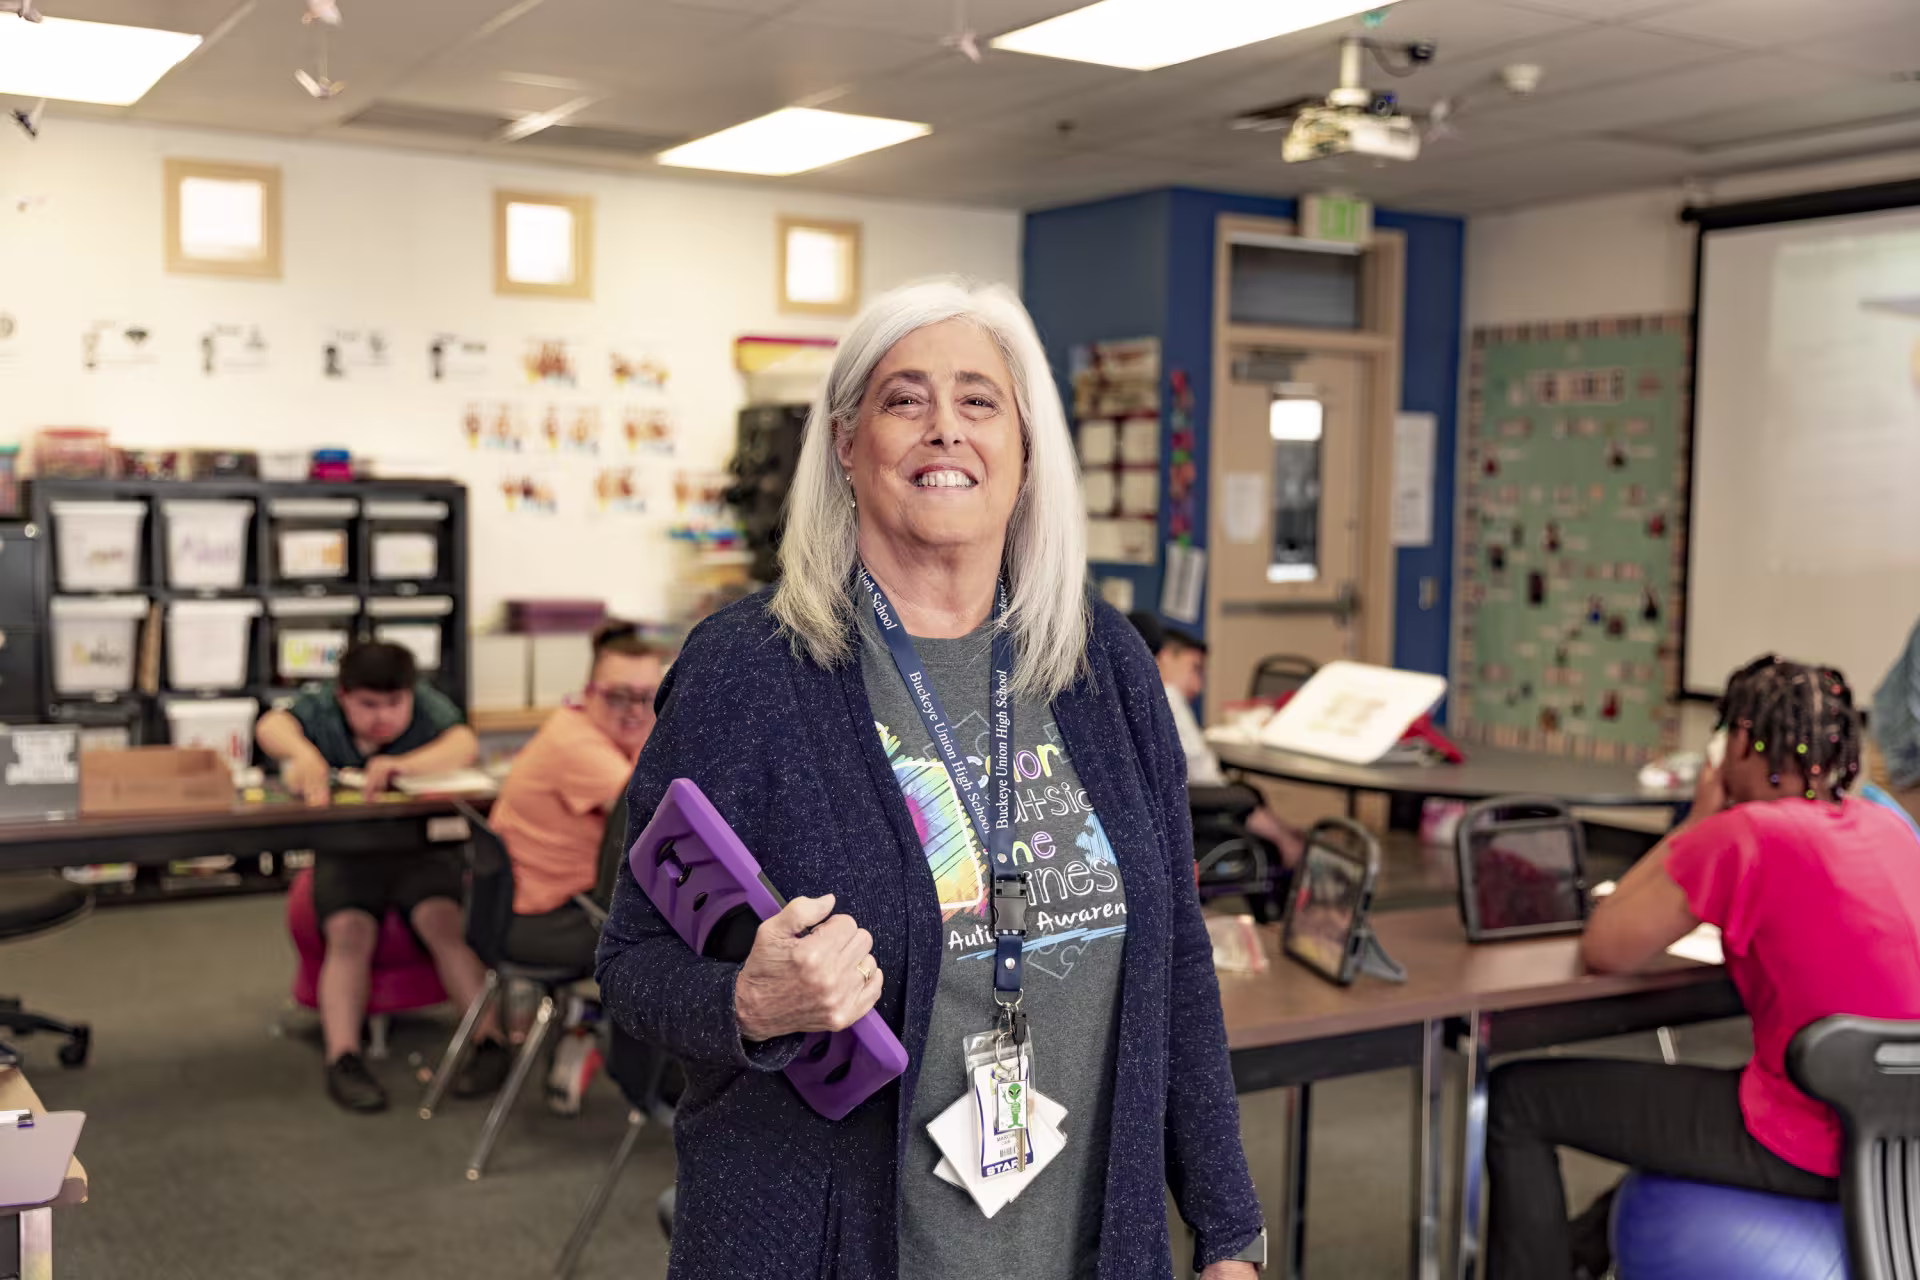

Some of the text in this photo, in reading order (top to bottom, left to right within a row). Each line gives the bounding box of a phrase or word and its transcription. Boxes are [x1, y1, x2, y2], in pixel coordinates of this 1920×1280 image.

[873, 593, 898, 630] School
[909, 671, 939, 722] Buckeye
[934, 722, 957, 759] Union
[951, 760, 974, 792] High
[995, 669, 1011, 829] Buckeye Union High School
